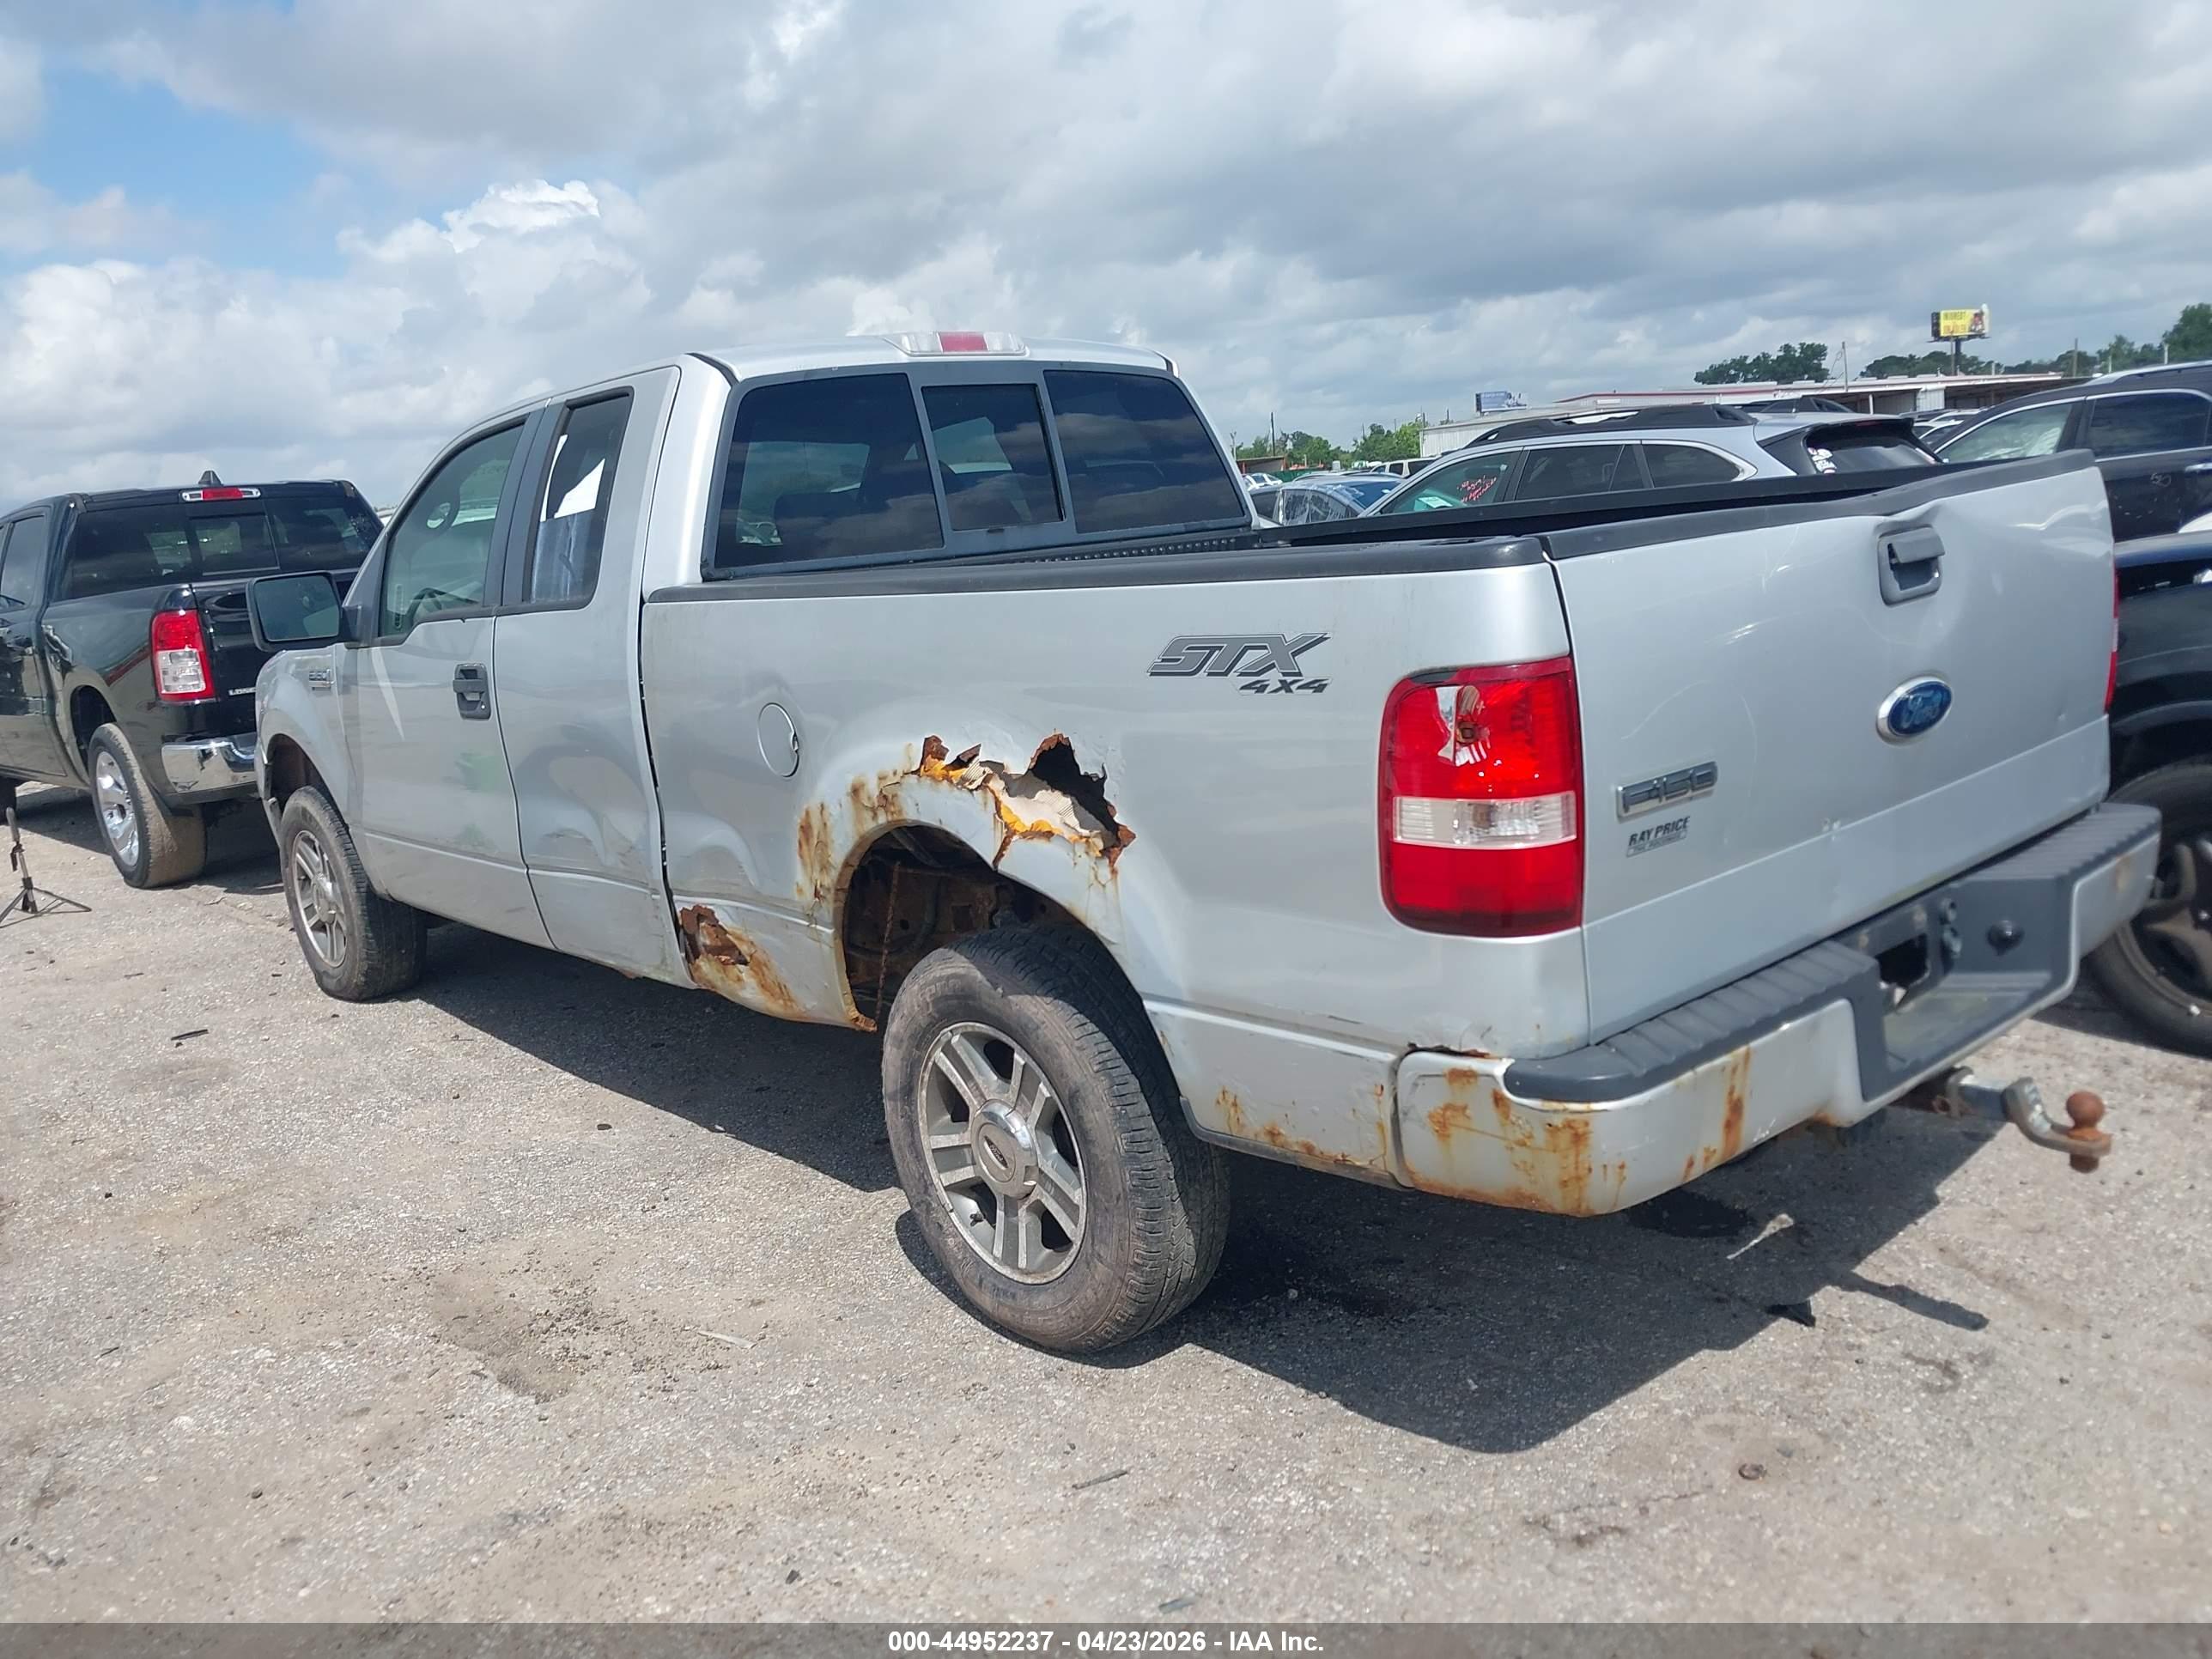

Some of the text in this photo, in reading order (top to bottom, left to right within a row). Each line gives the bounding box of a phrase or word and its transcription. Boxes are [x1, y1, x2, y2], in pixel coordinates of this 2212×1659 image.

[1146, 633, 1331, 677] STX
[1628, 828, 1654, 847] RAY
[1655, 816, 1691, 838] PRICE
